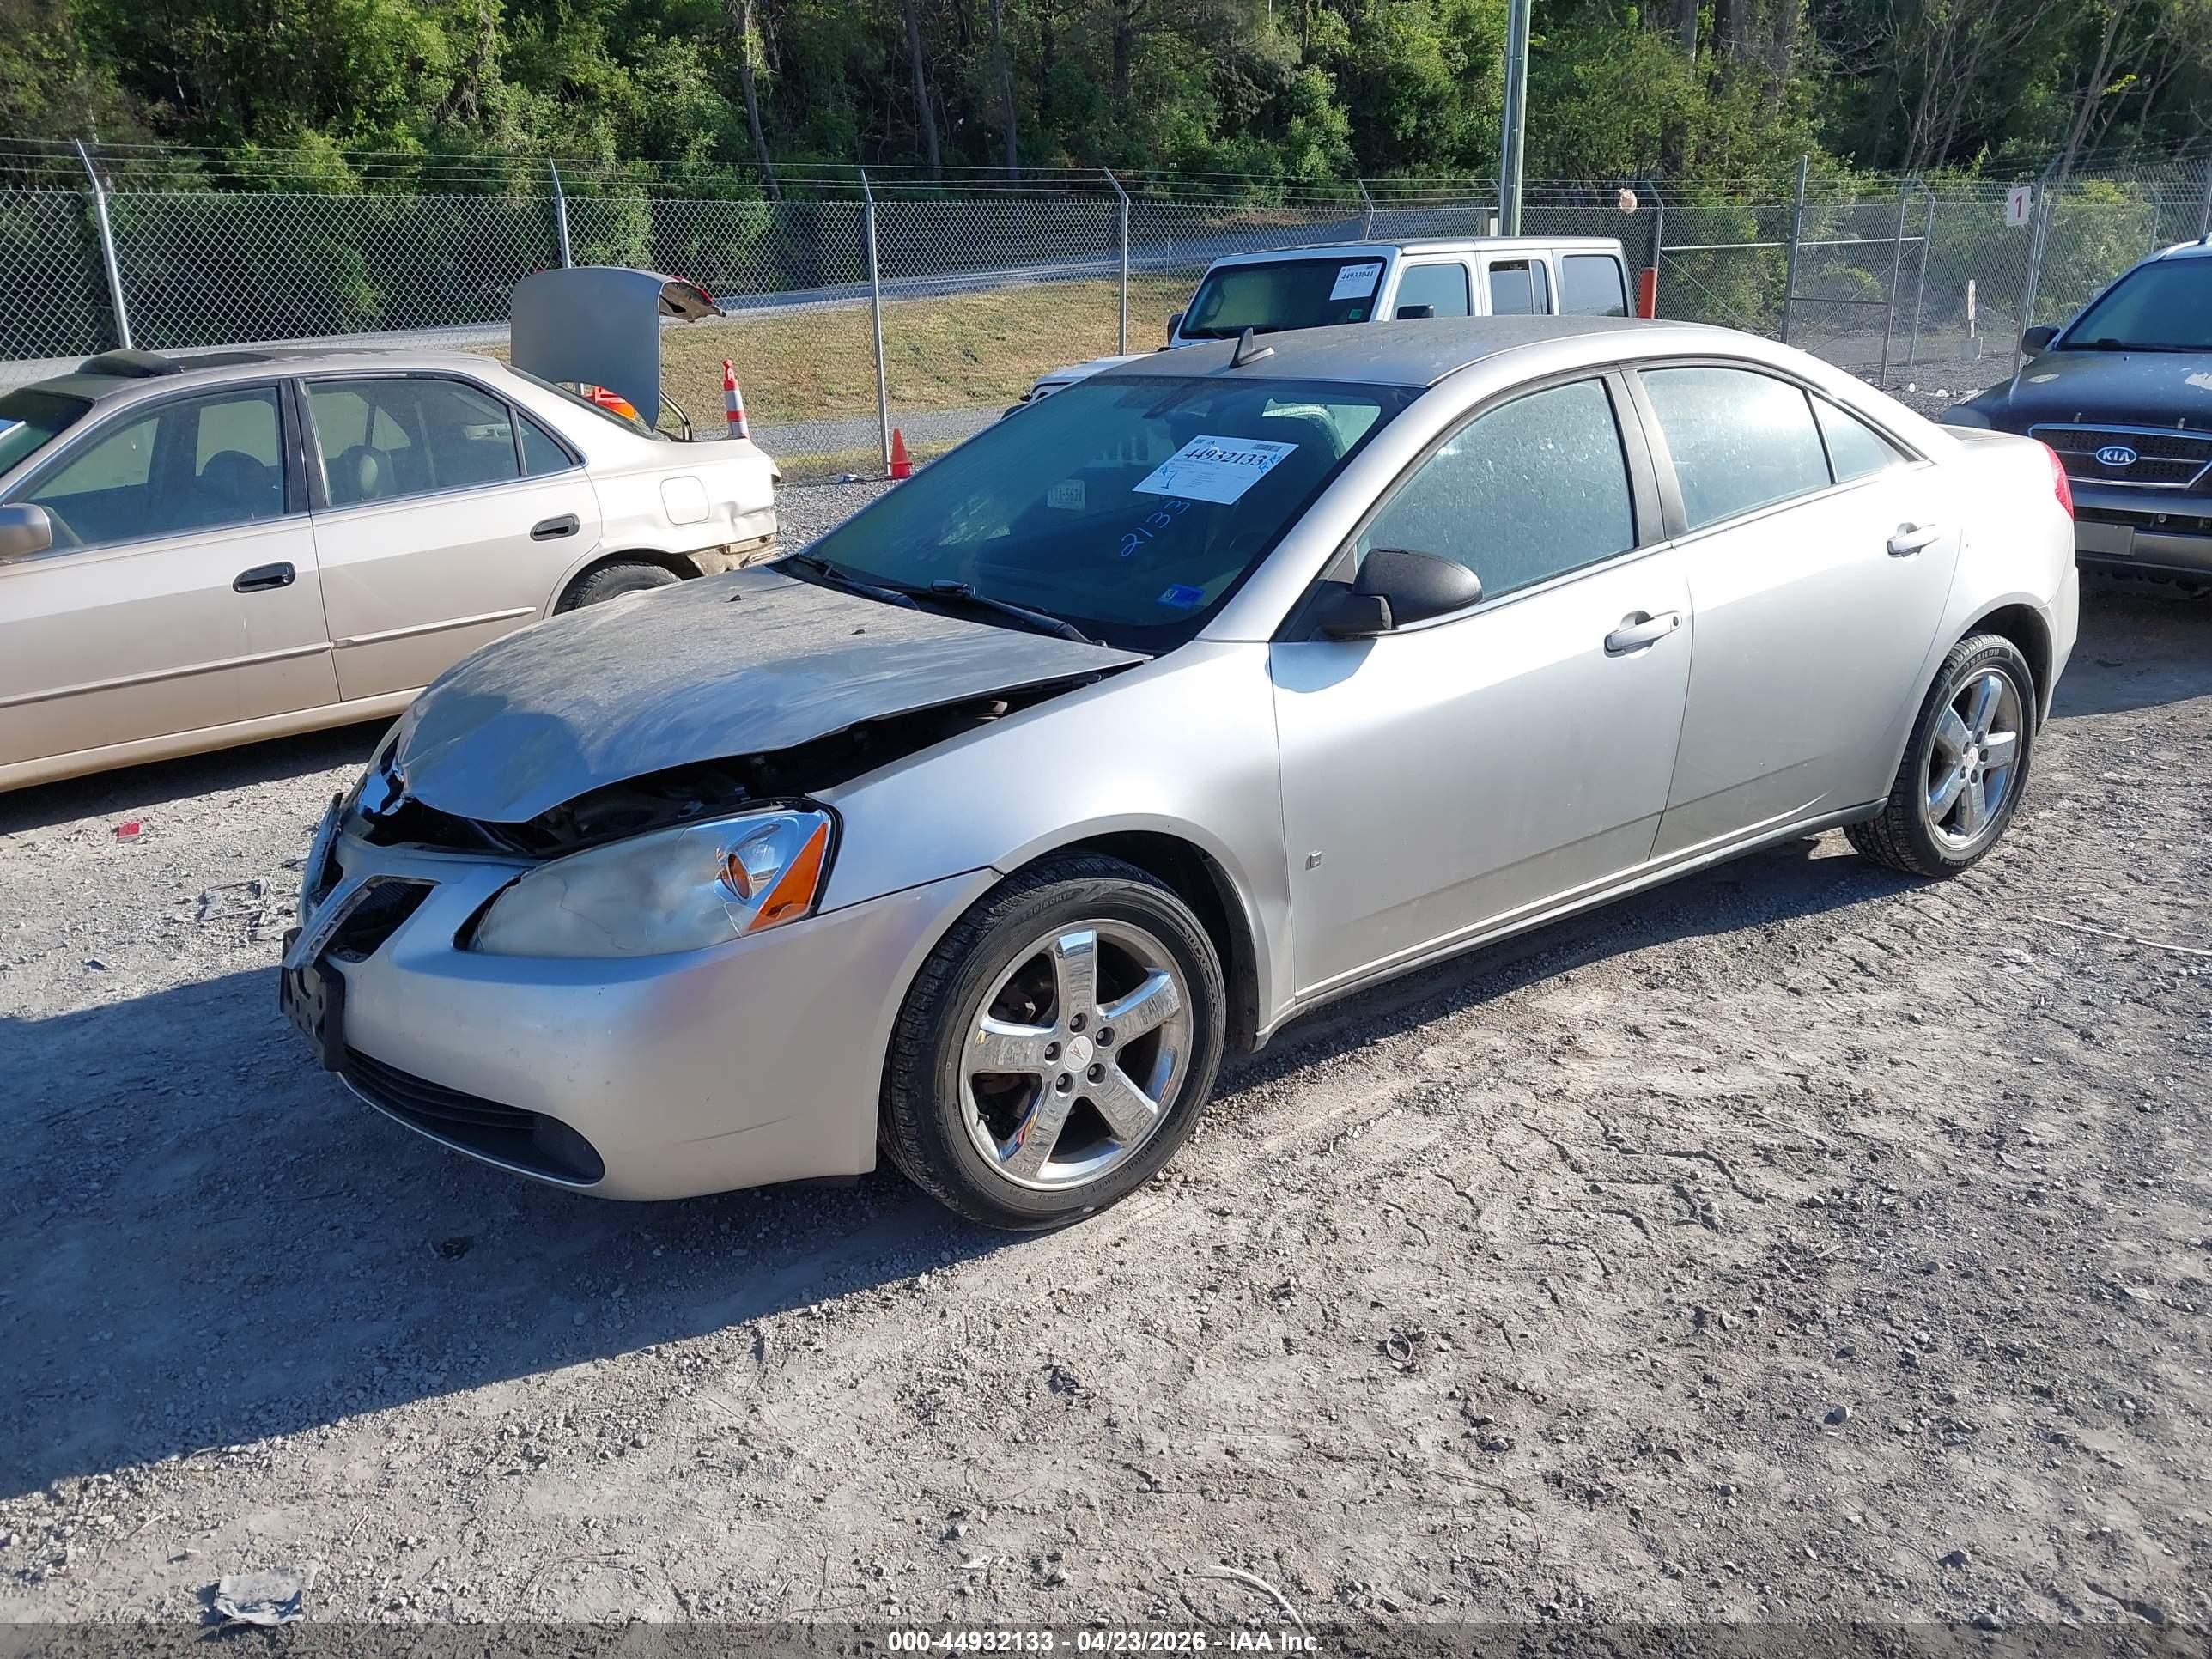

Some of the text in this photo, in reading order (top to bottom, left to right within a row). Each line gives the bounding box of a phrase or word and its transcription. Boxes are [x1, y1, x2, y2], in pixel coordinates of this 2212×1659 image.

[2015, 194, 2023, 218] 1
[1184, 447, 1267, 466] 44932133
[2102, 450, 2130, 462] KIA
[1121, 500, 1191, 557] 2133
